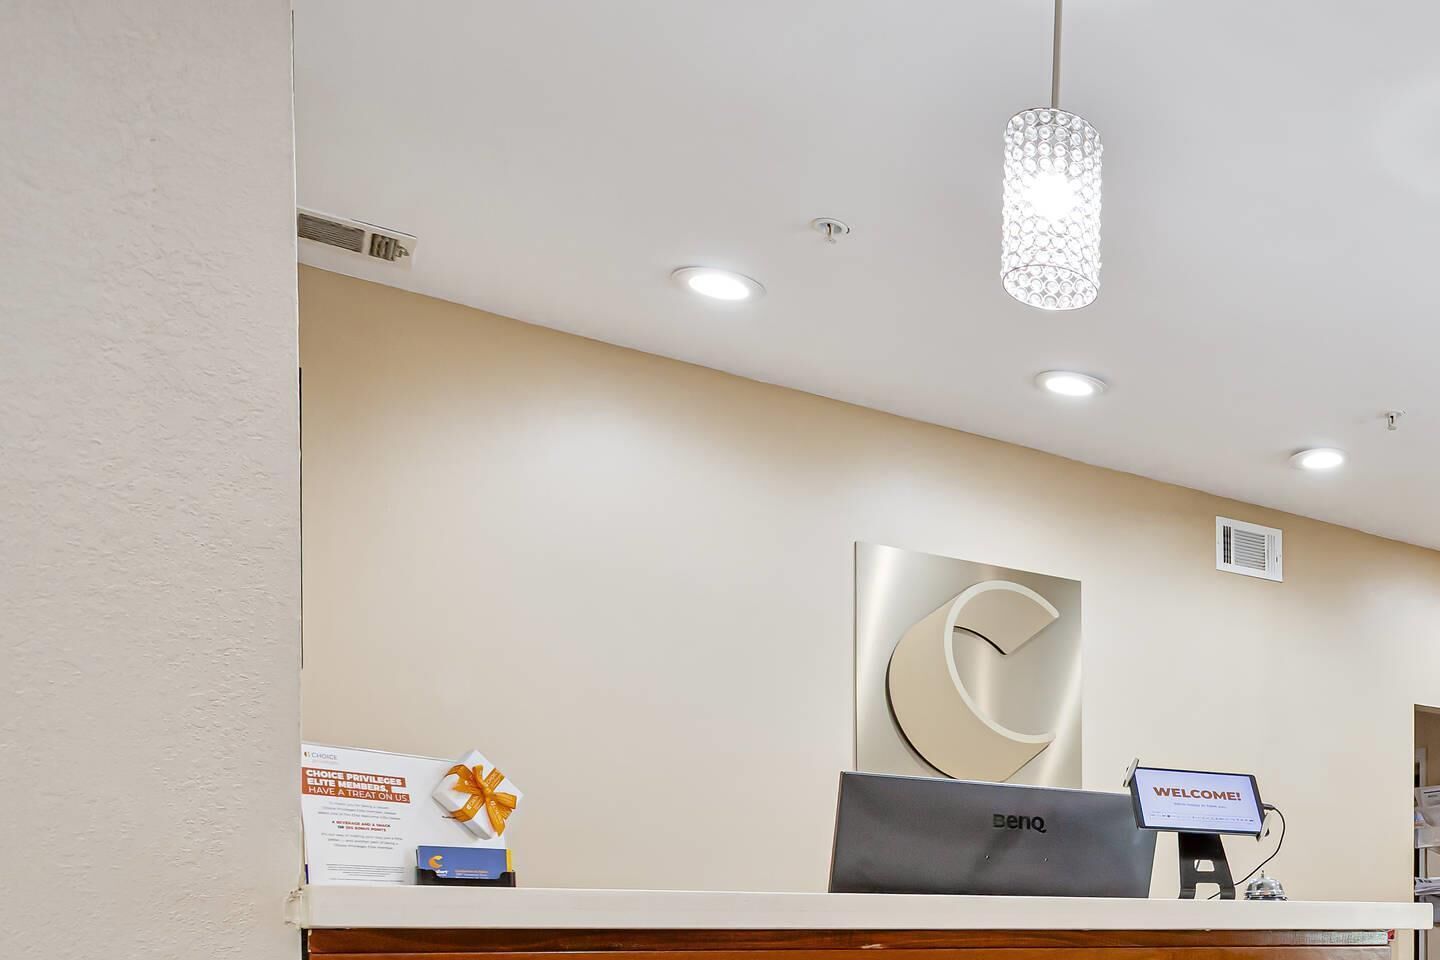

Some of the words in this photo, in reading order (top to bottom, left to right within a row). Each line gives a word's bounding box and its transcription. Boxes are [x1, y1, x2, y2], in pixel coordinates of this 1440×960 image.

[306, 769, 344, 780] CHOICE
[346, 772, 402, 786] PRIVILEGES
[307, 777, 336, 787] ELITE
[308, 786, 336, 796] HAVE
[338, 788, 345, 796] A
[346, 789, 377, 799] TREAT
[378, 792, 393, 801] ON
[1153, 786, 1242, 801] WELCOME!
[992, 814, 1047, 833] BenQ
